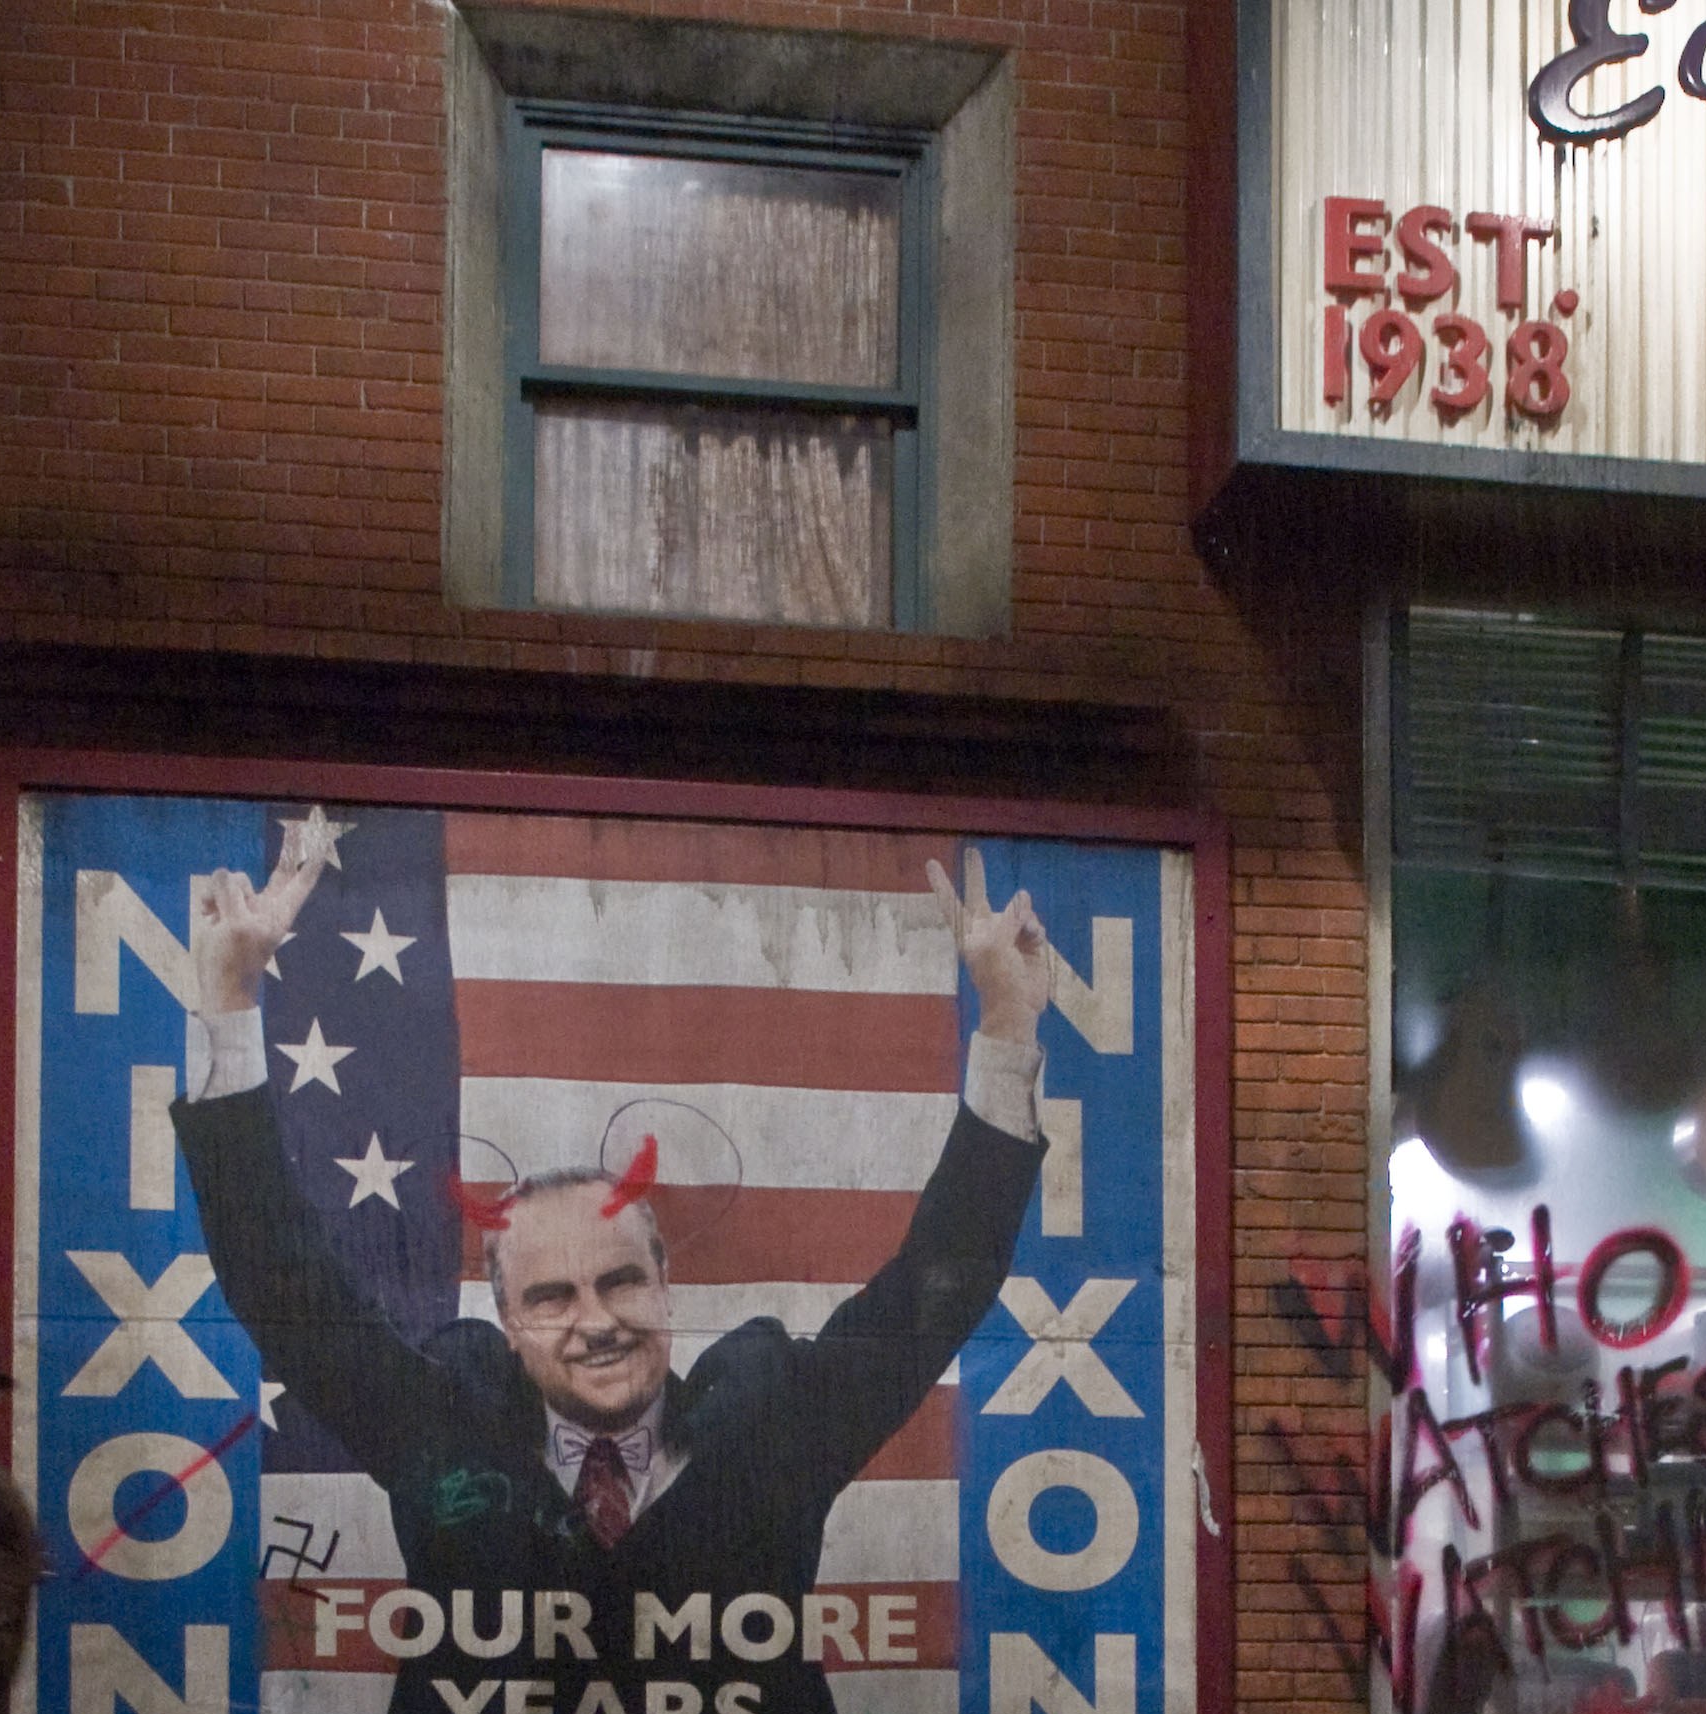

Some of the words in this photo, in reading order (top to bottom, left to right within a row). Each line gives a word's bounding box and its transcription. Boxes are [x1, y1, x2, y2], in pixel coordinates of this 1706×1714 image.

[1323, 195, 1580, 314] EST.
[1323, 305, 1571, 417] 1938
[1271, 1203, 1691, 1396] WHO
[313, 1588, 600, 1661] FOUR
[633, 1591, 919, 1663] MORE
